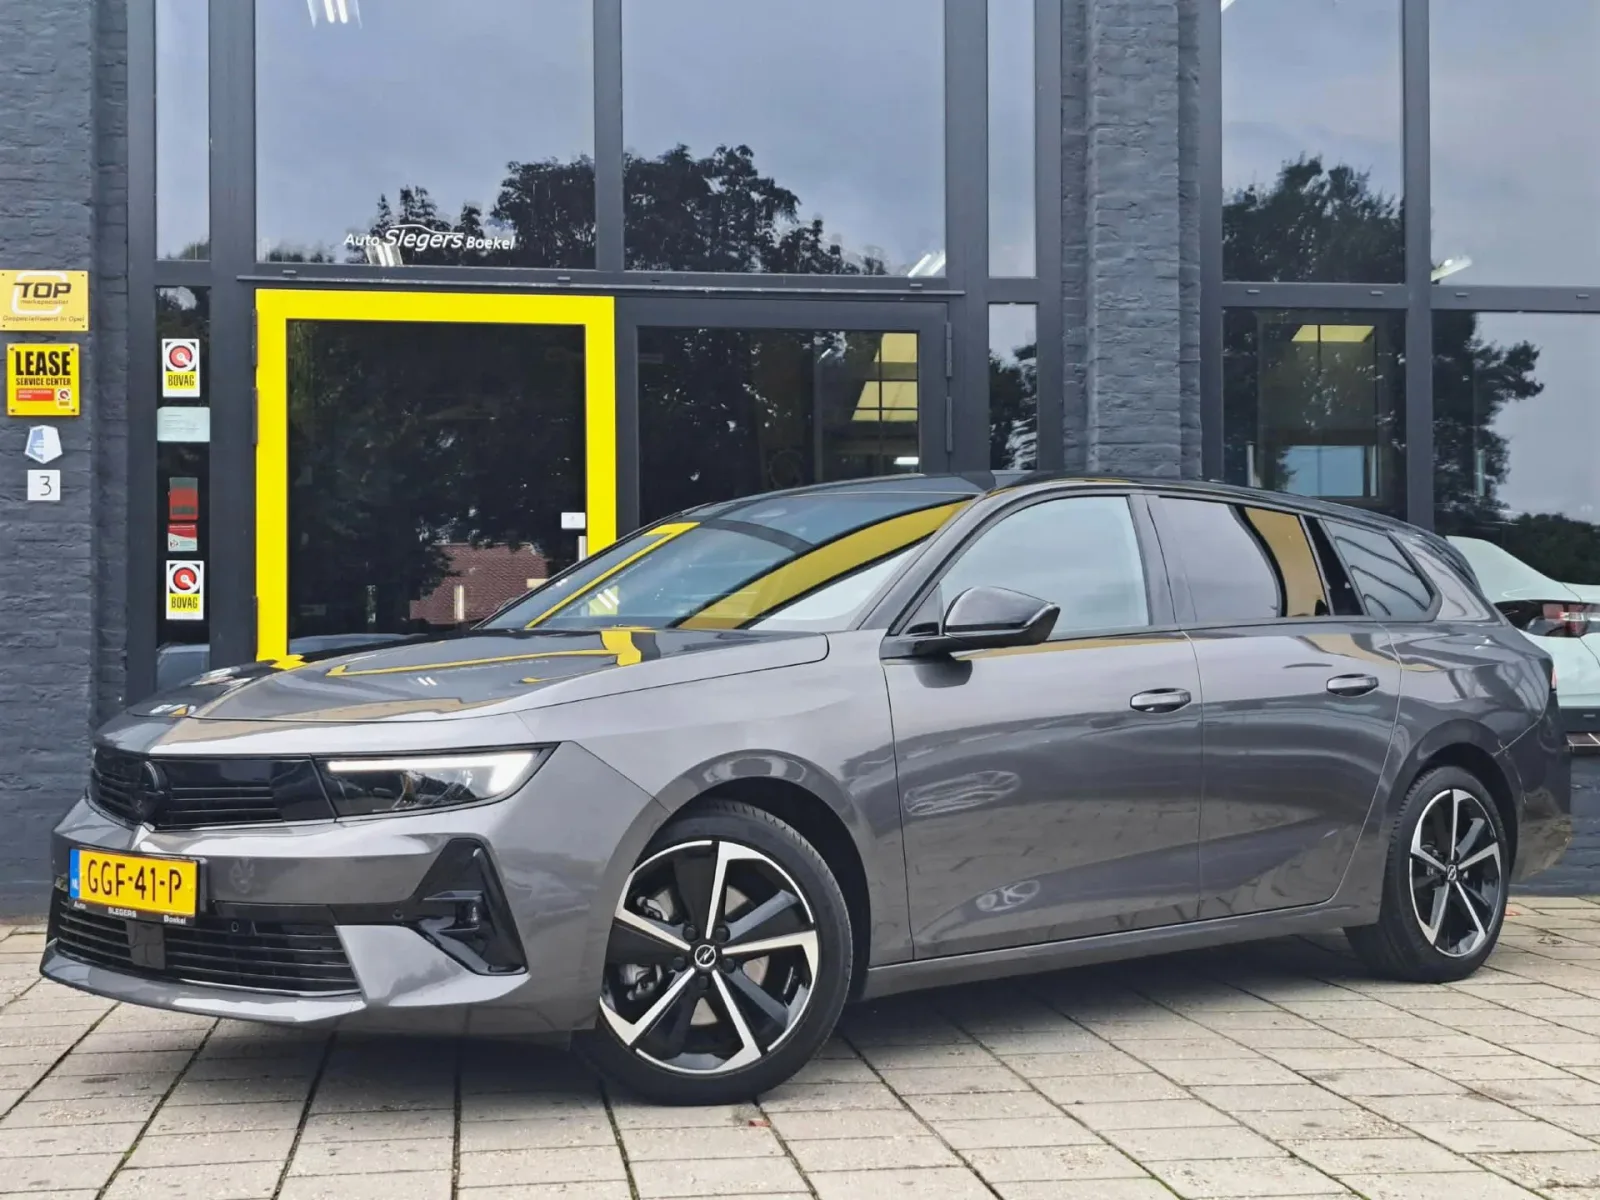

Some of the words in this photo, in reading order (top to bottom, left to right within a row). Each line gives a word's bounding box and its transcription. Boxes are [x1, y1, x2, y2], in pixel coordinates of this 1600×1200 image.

[343, 233, 380, 246] Auto
[384, 229, 464, 251] Slegers
[466, 236, 516, 250] Boekel
[13, 282, 72, 298] TOP
[15, 351, 71, 376] LEASE
[16, 378, 44, 386] SERVICE
[46, 378, 71, 386] CENTER
[167, 374, 195, 387] BOVAG
[40, 475, 52, 496] 3
[171, 596, 198, 609] BOVAG
[87, 859, 182, 904] GGF-41-P
